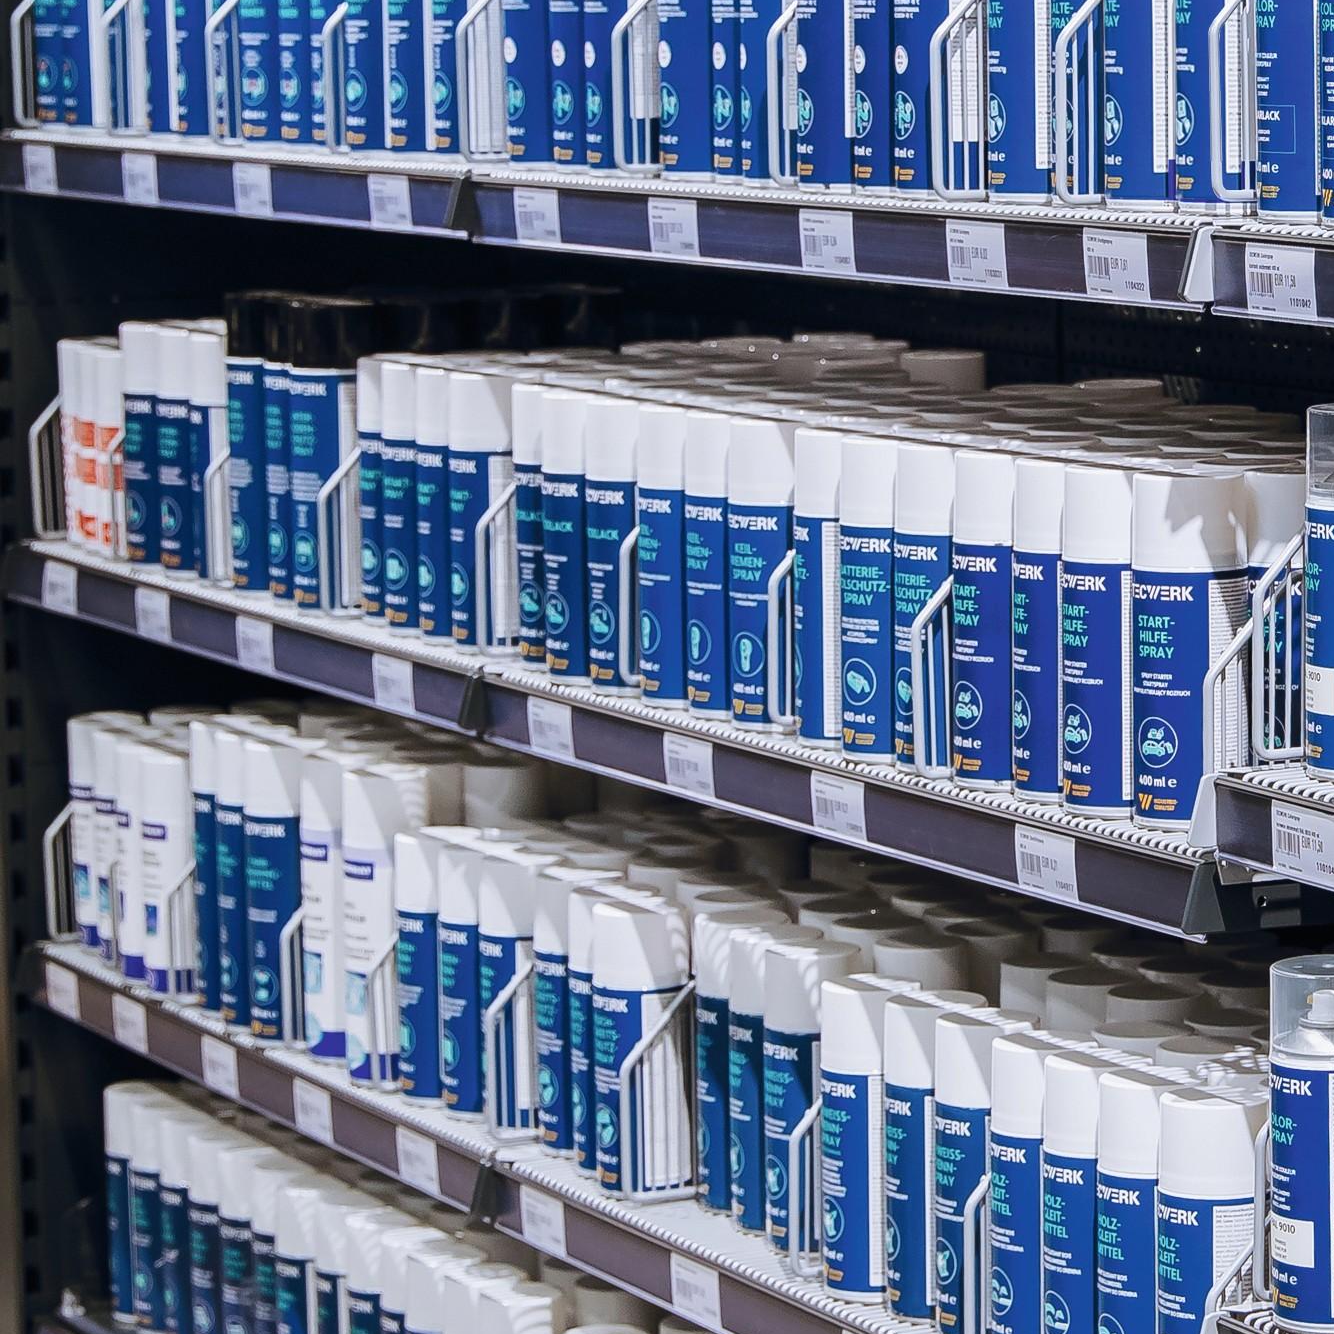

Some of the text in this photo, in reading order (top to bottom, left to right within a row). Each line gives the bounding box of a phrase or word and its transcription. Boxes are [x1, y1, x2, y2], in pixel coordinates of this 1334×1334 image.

[1111, 258, 1119, 269] EUR
[1275, 274, 1296, 289] EUR 11,50
[844, 588, 873, 605] SPRAY
[1139, 615, 1175, 628] START-
[1140, 631, 1172, 643] HILFE-
[1140, 645, 1174, 658] SPRAY
[1139, 775, 1165, 787] 400 ml
[1302, 836, 1323, 853] EUR 11,50
[1278, 1222, 1295, 1235] 9010
